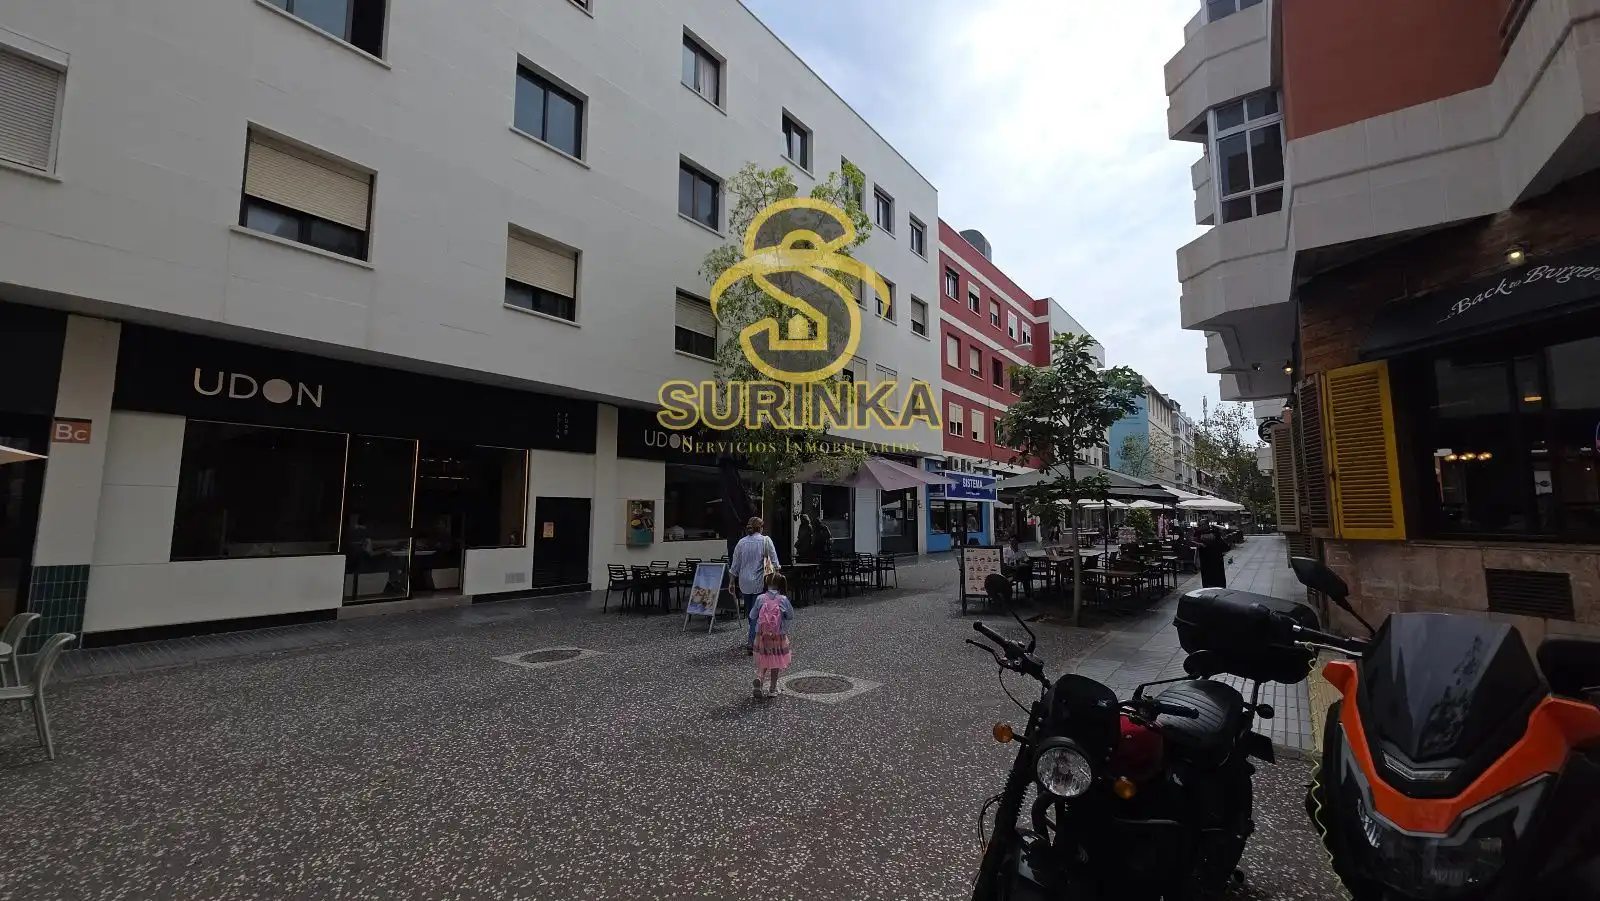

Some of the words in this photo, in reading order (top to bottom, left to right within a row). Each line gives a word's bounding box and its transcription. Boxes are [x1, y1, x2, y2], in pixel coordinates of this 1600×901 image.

[1452, 278, 1512, 314] Back
[194, 367, 323, 408] UDON
[55, 423, 88, 441] Bc
[644, 429, 693, 453] UDON
